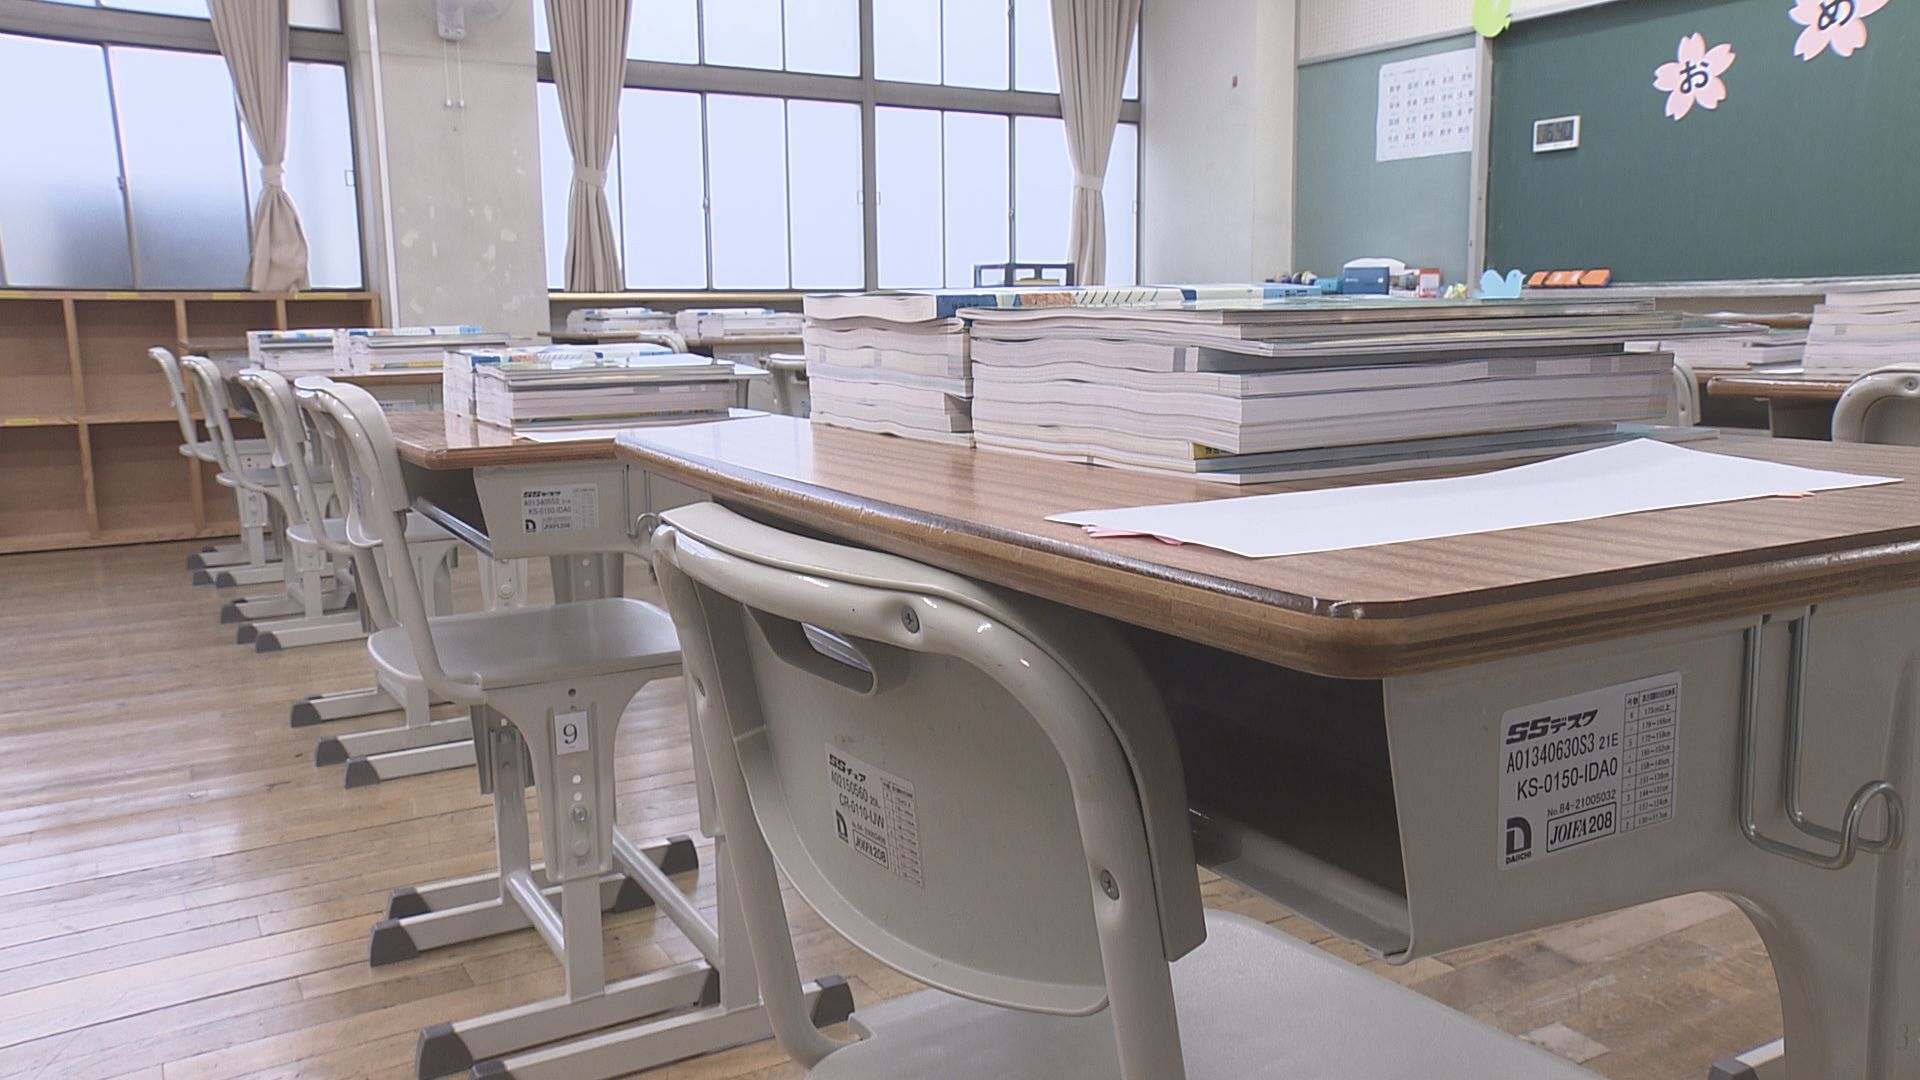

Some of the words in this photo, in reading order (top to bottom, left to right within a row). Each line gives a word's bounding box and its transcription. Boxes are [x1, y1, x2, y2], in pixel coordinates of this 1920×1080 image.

[1680, 60, 1709, 94] お
[1817, 0, 1855, 30] め
[563, 723, 577, 744] 9
[1506, 709, 1598, 744] SSデスク
[1507, 733, 1594, 774] A01340630S3
[1599, 732, 1619, 750] 21E
[1517, 757, 1618, 800] KS-0150-IDA0
